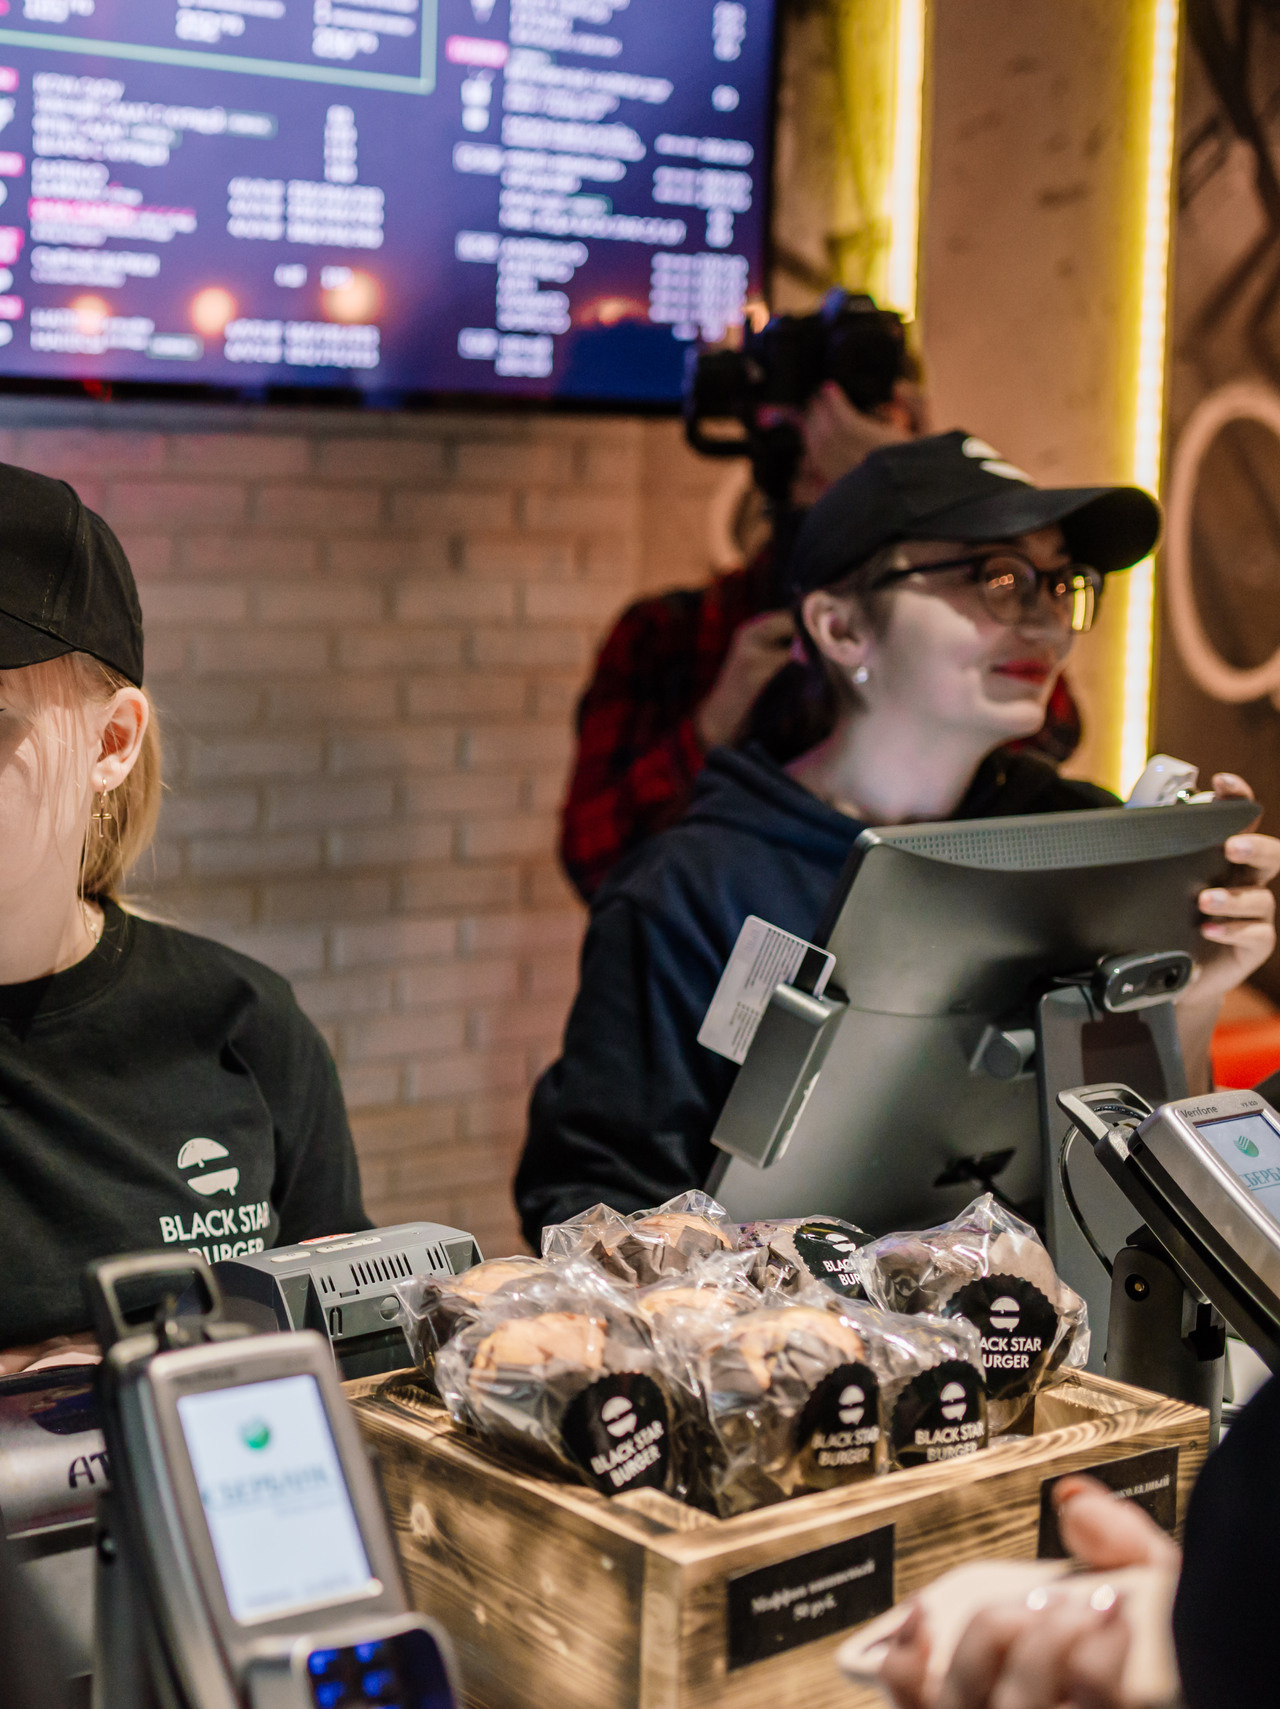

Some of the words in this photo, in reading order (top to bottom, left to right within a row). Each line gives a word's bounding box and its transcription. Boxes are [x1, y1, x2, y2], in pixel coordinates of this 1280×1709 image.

[1180, 1105, 1219, 1119] Verifone
[159, 1208, 238, 1243] BLACK
[238, 1201, 271, 1234] STAR
[838, 1273, 862, 1287] BUR
[980, 1336, 1009, 1352] ACK
[1010, 1336, 1042, 1352] STAR
[982, 1353, 1030, 1369] URGER
[914, 1425, 960, 1446] BLACK
[959, 1420, 985, 1440] STAR
[590, 1438, 637, 1476] BLACK
[632, 1419, 665, 1451] STAR
[818, 1446, 870, 1467] BURGER
[609, 1443, 662, 1488] BURGER
